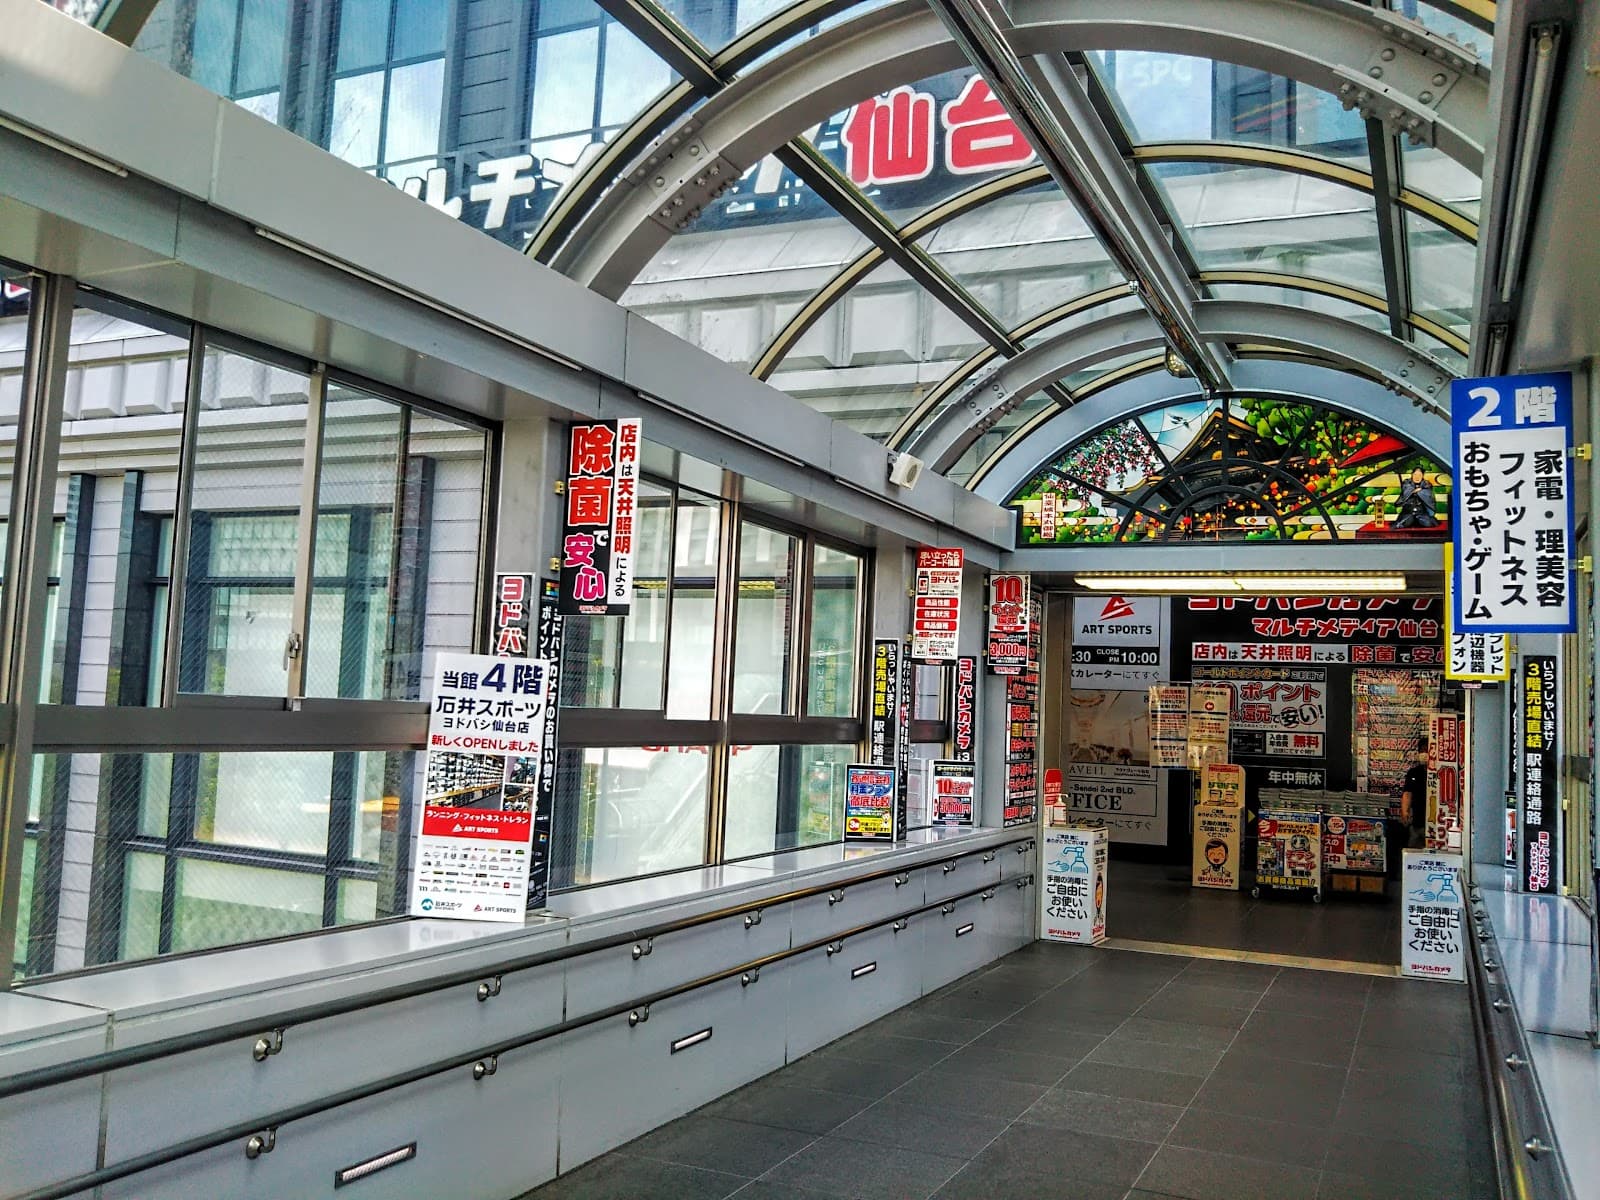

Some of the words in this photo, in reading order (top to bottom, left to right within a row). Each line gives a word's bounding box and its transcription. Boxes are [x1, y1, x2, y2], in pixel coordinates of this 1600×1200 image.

[843, 73, 1039, 186] 仙台
[1468, 386, 1557, 427] 2階
[564, 424, 616, 600] 除菌で安心
[614, 424, 637, 597] 店内は天井照明による
[1463, 441, 1493, 620] おもちゃ・ゲーム
[1499, 453, 1528, 606] フィットネス
[1533, 449, 1565, 608] 家電・理美容
[497, 576, 527, 661] ヨドバ
[1082, 625, 1104, 634] ART
[1108, 626, 1152, 634] SPORTS
[1251, 618, 1438, 638] マルチメディア仙台
[1121, 652, 1158, 663] 10:00
[1193, 644, 1346, 663] 店内は天井照明による
[1470, 633, 1485, 673] 辺機器
[442, 663, 543, 695] 当館4階
[1240, 682, 1321, 702] ポイント
[436, 695, 541, 719] 石井スポーツ
[957, 658, 973, 750] ヨドバシカメラ
[1526, 663, 1543, 749] 3階売場直結
[443, 717, 530, 734] ヨドバシ仙台店
[431, 734, 539, 753] 新しくOPENしました
[1293, 734, 1319, 748] 無料
[1268, 770, 1322, 786] 年中無休
[1100, 785, 1113, 793] 2nd
[1526, 752, 1542, 825] 駅連絡通路
[1068, 792, 1122, 810] FICE
[1046, 875, 1088, 885] 手指の消毒に
[1046, 884, 1089, 897] ご自由に
[496, 906, 517, 914] SPORTS
[1051, 895, 1083, 908] お使い
[1407, 904, 1459, 916] 手指の消毒に
[1046, 906, 1088, 920] ください
[1408, 914, 1459, 929] ご自由に
[1048, 928, 1081, 937] ヨドバシカメラ
[1414, 927, 1453, 941] お使い
[1408, 939, 1459, 954] ください
[1411, 963, 1452, 973] ヨドバシカメラ
